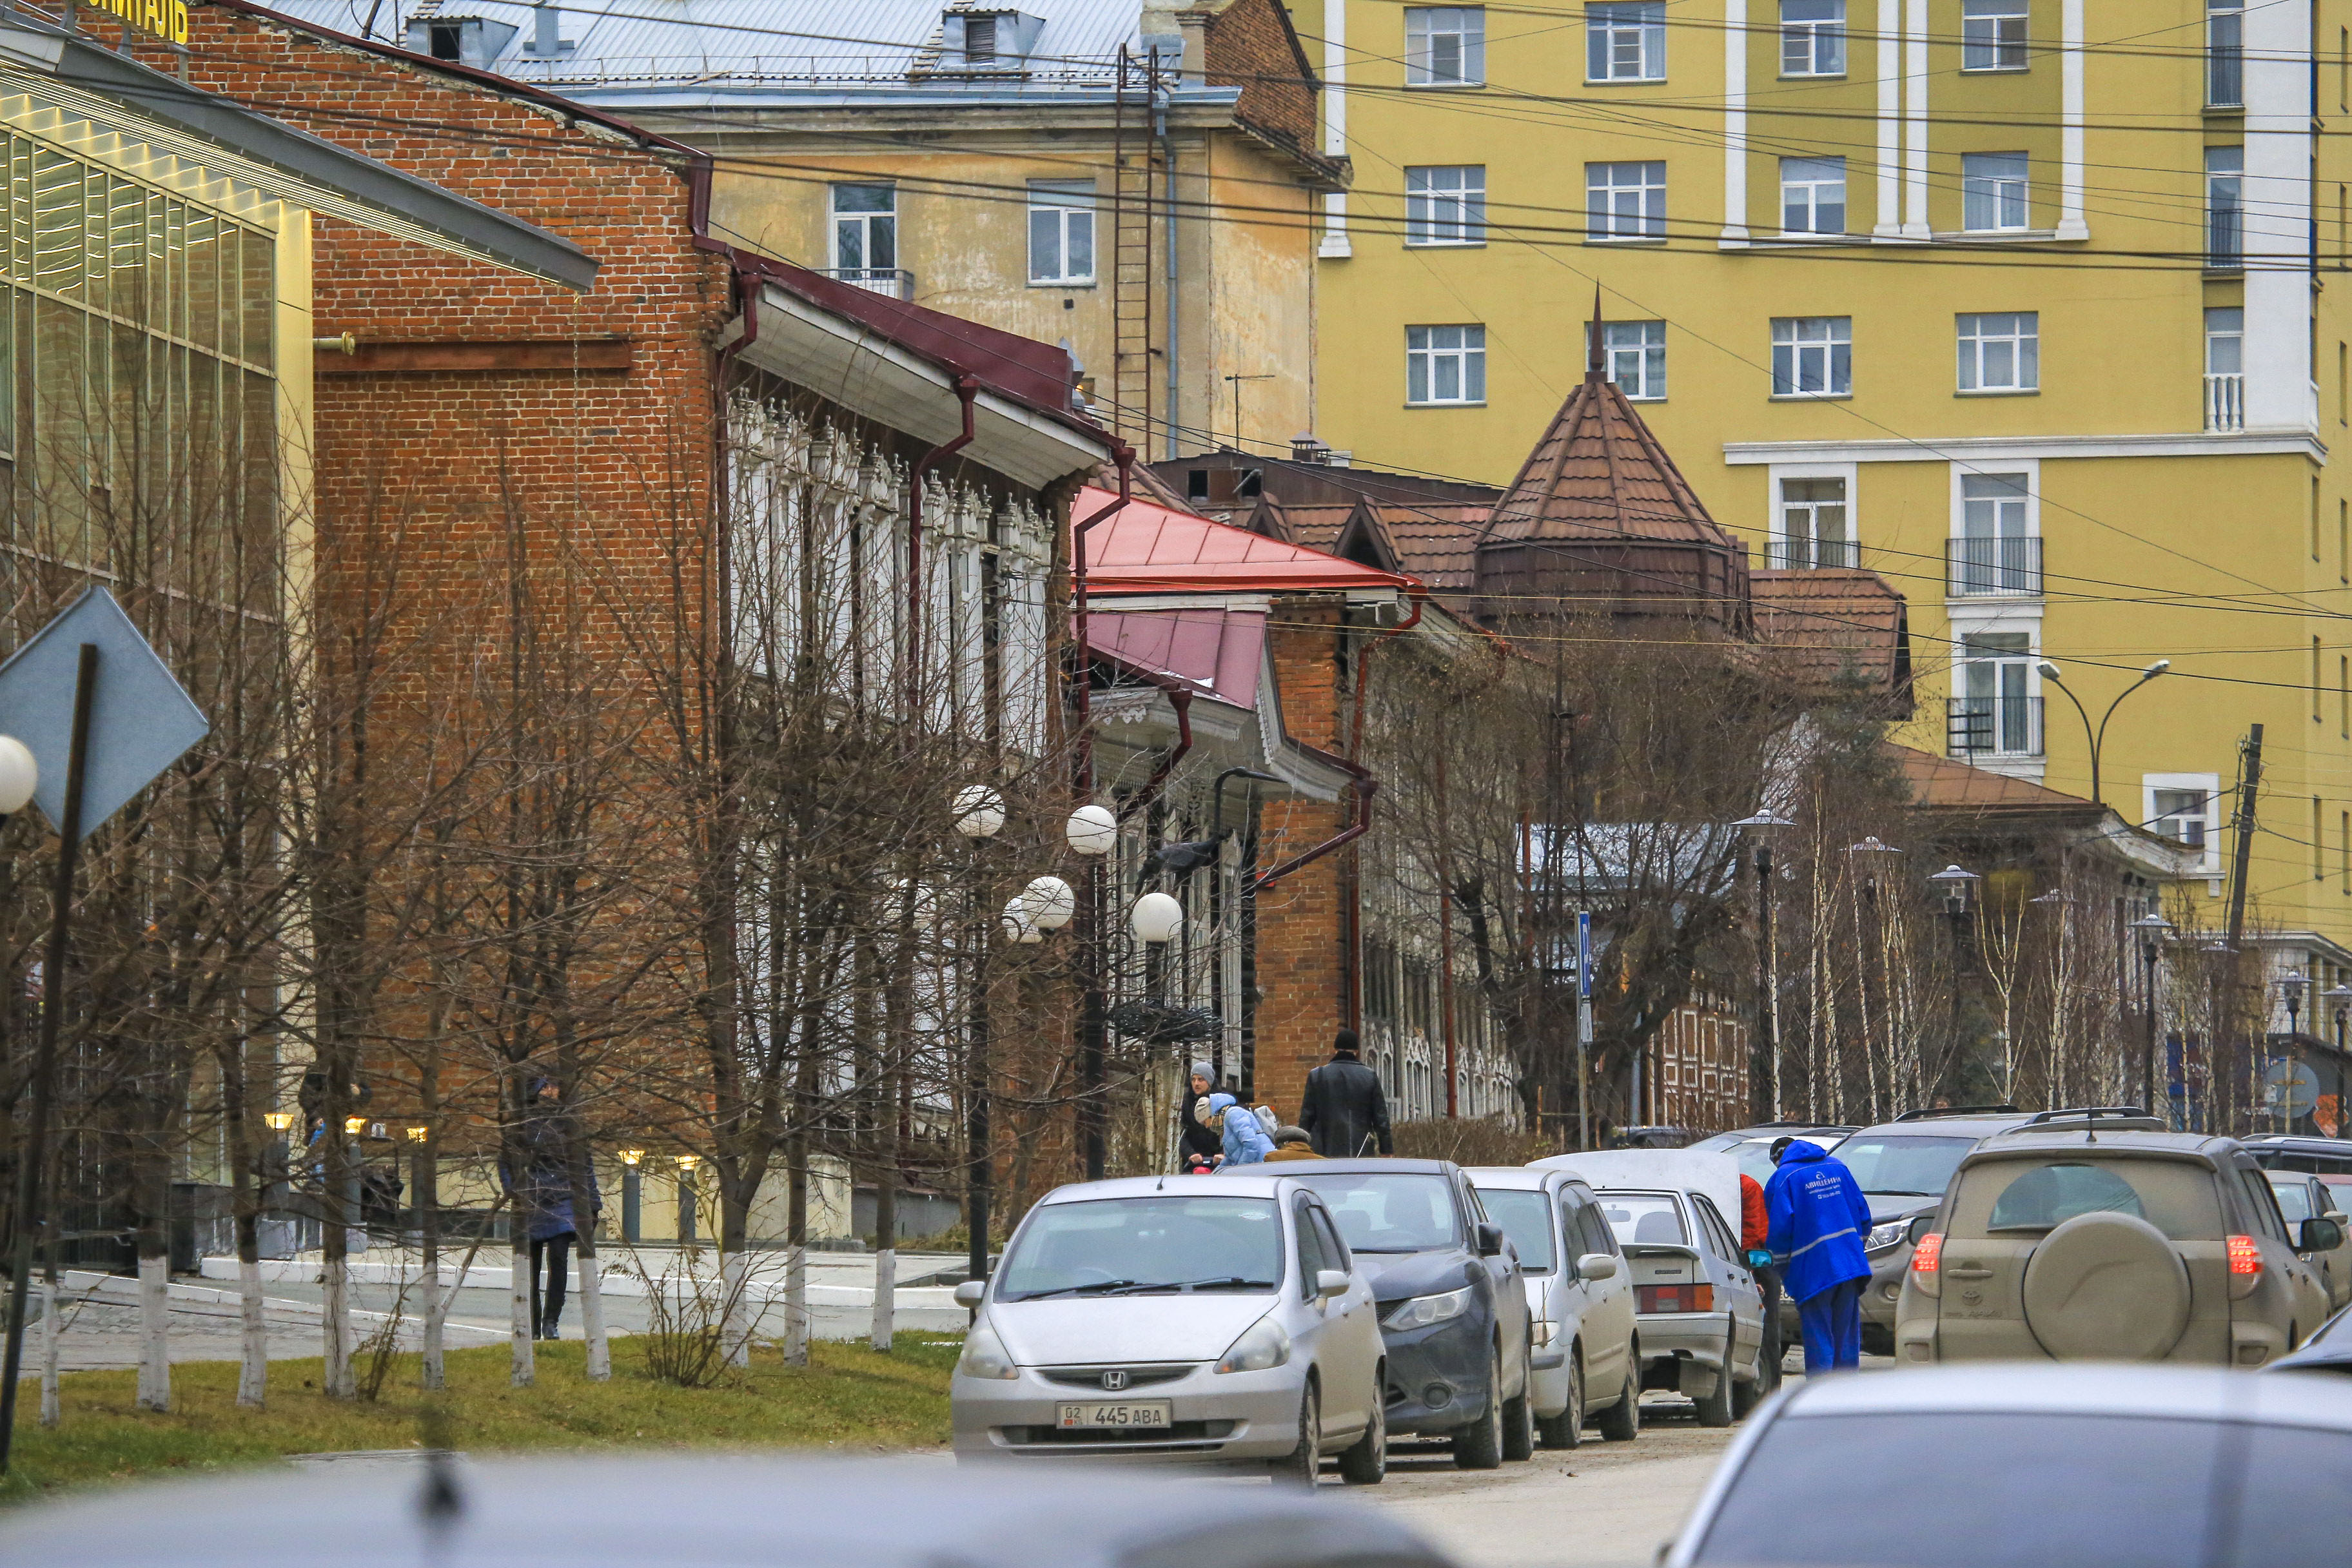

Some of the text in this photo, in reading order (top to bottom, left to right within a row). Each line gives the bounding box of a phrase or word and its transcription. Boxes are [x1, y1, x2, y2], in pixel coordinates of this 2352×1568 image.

[89, 0, 188, 45] ТАЛЬ
[1065, 1407, 1161, 1424] 02 445 ABA
